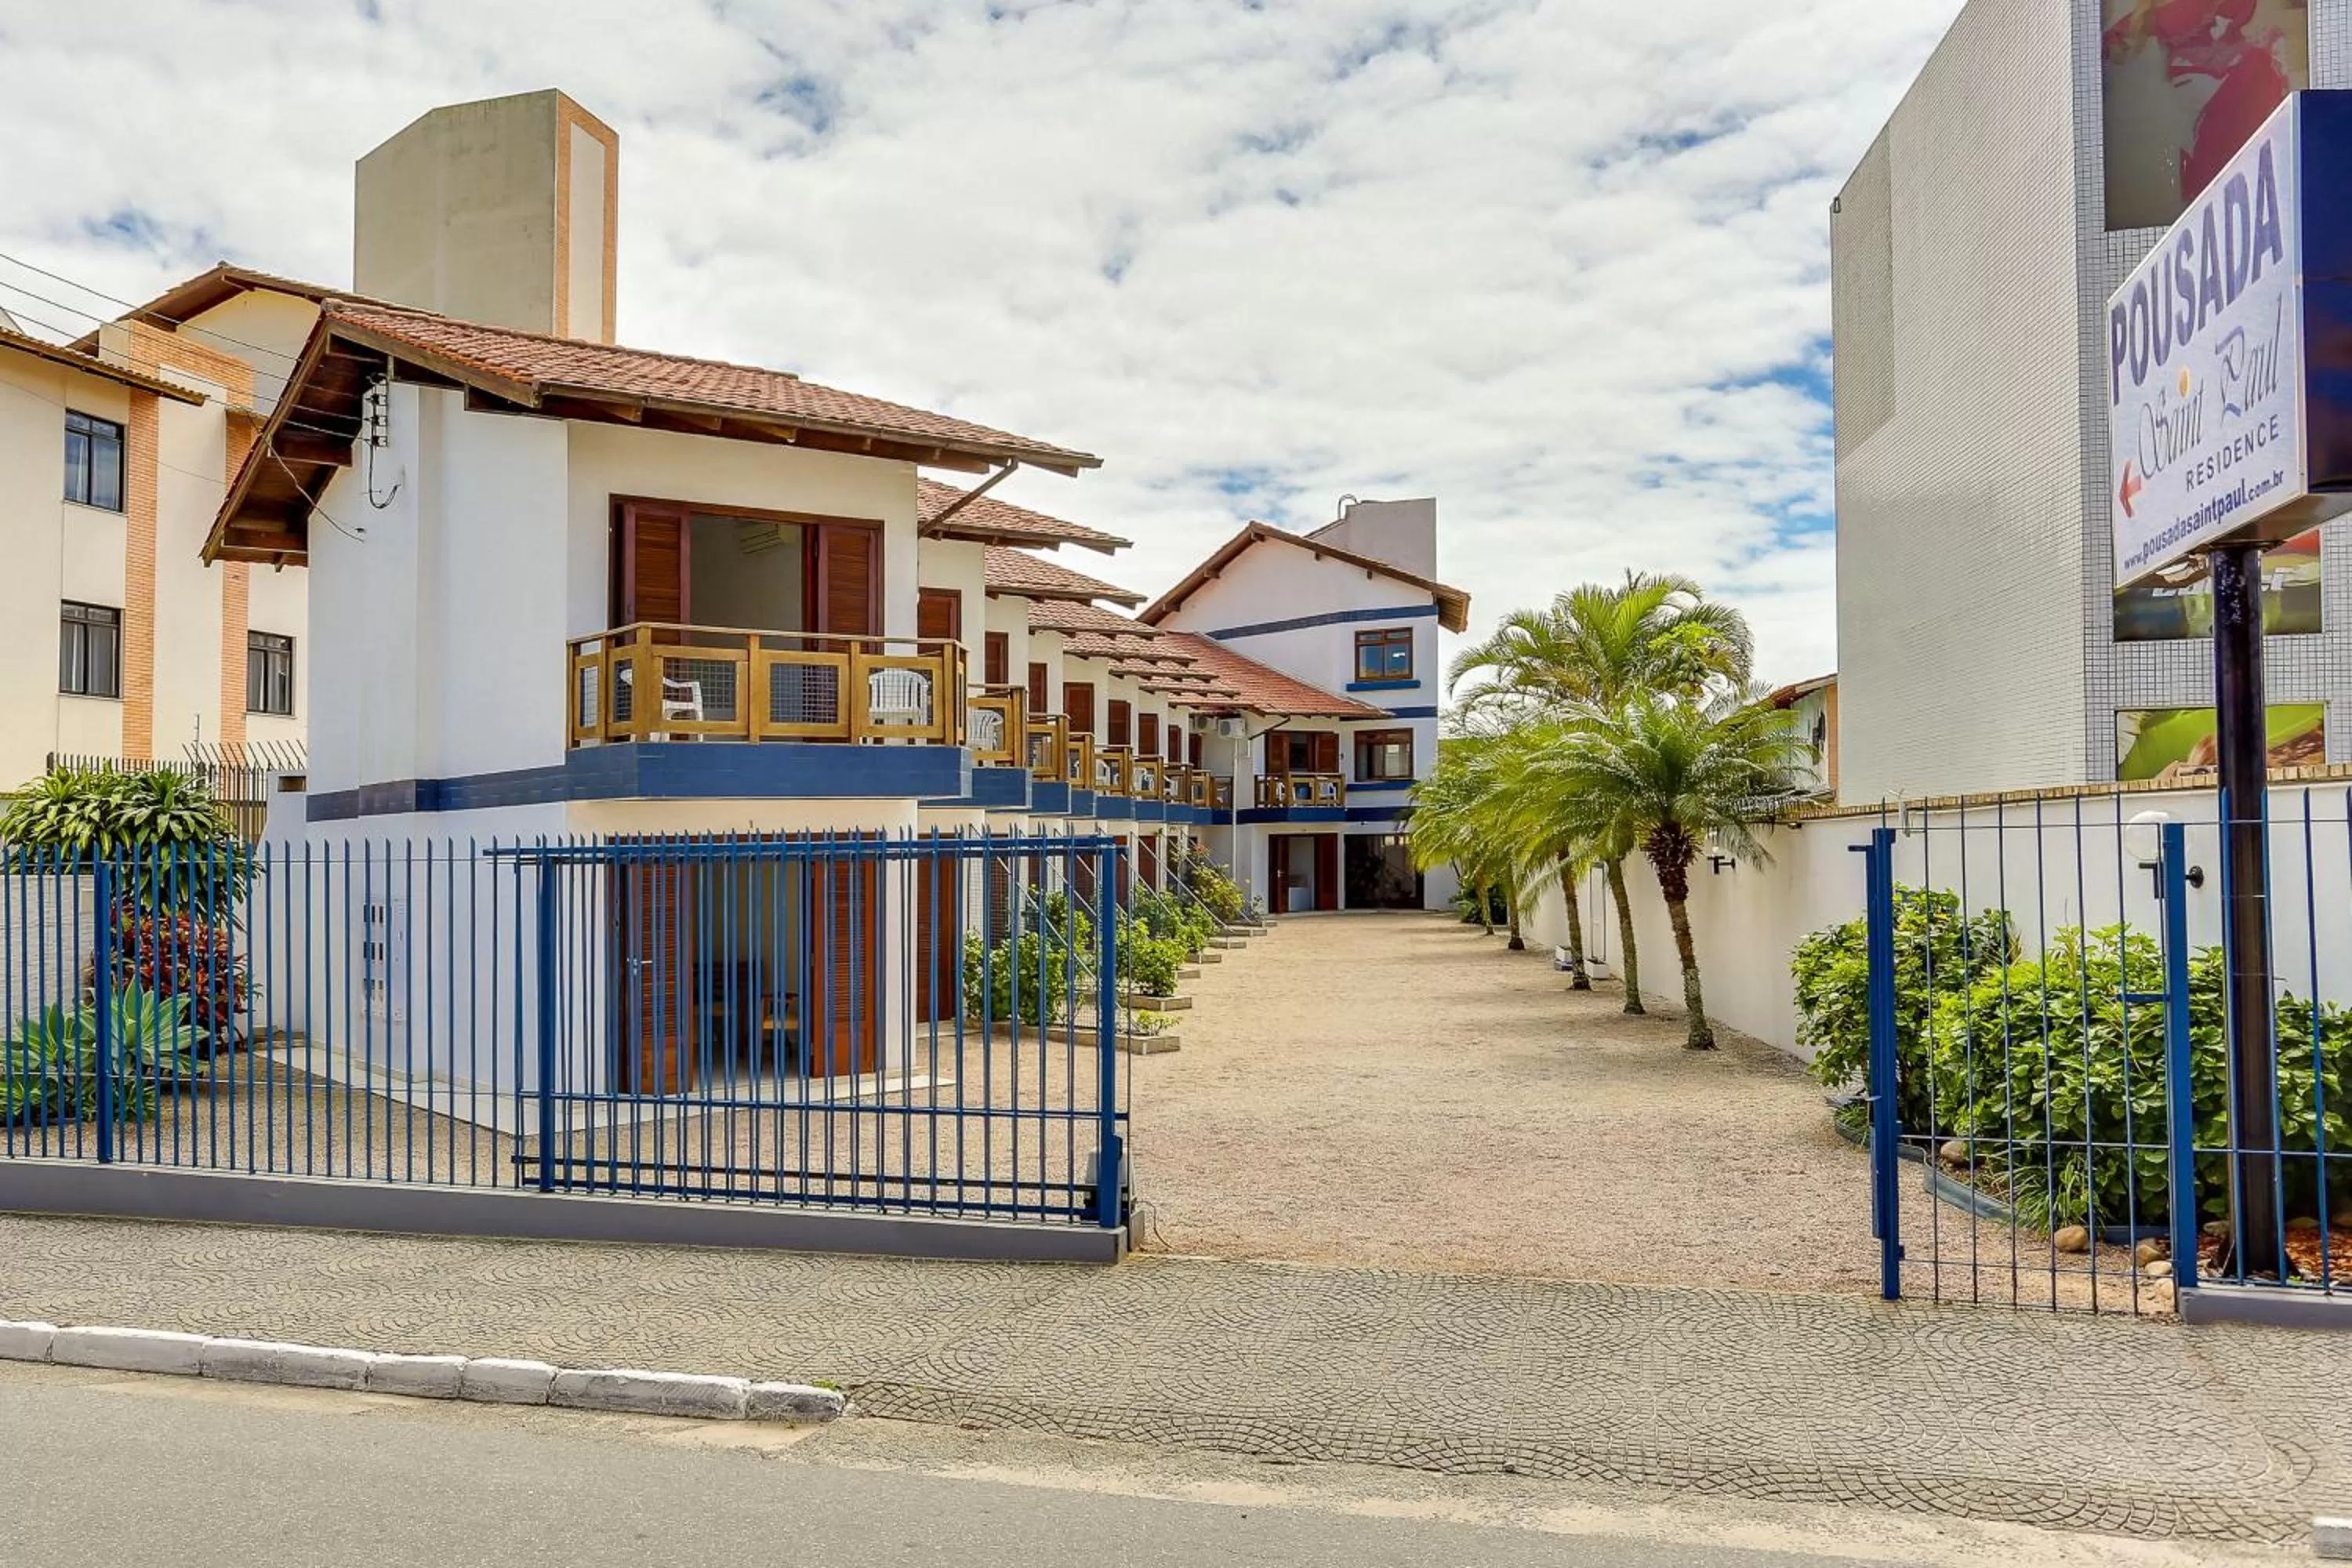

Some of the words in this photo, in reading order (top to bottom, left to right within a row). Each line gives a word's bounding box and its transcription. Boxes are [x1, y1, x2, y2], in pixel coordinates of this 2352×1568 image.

[2111, 138, 2283, 406] POUSADA
[2138, 368, 2204, 480] Saint
[2216, 291, 2282, 427] Paul
[2187, 413, 2280, 492] RESIDENCE
[2124, 470, 2284, 570] www.pousadasaintpaul.com.br
